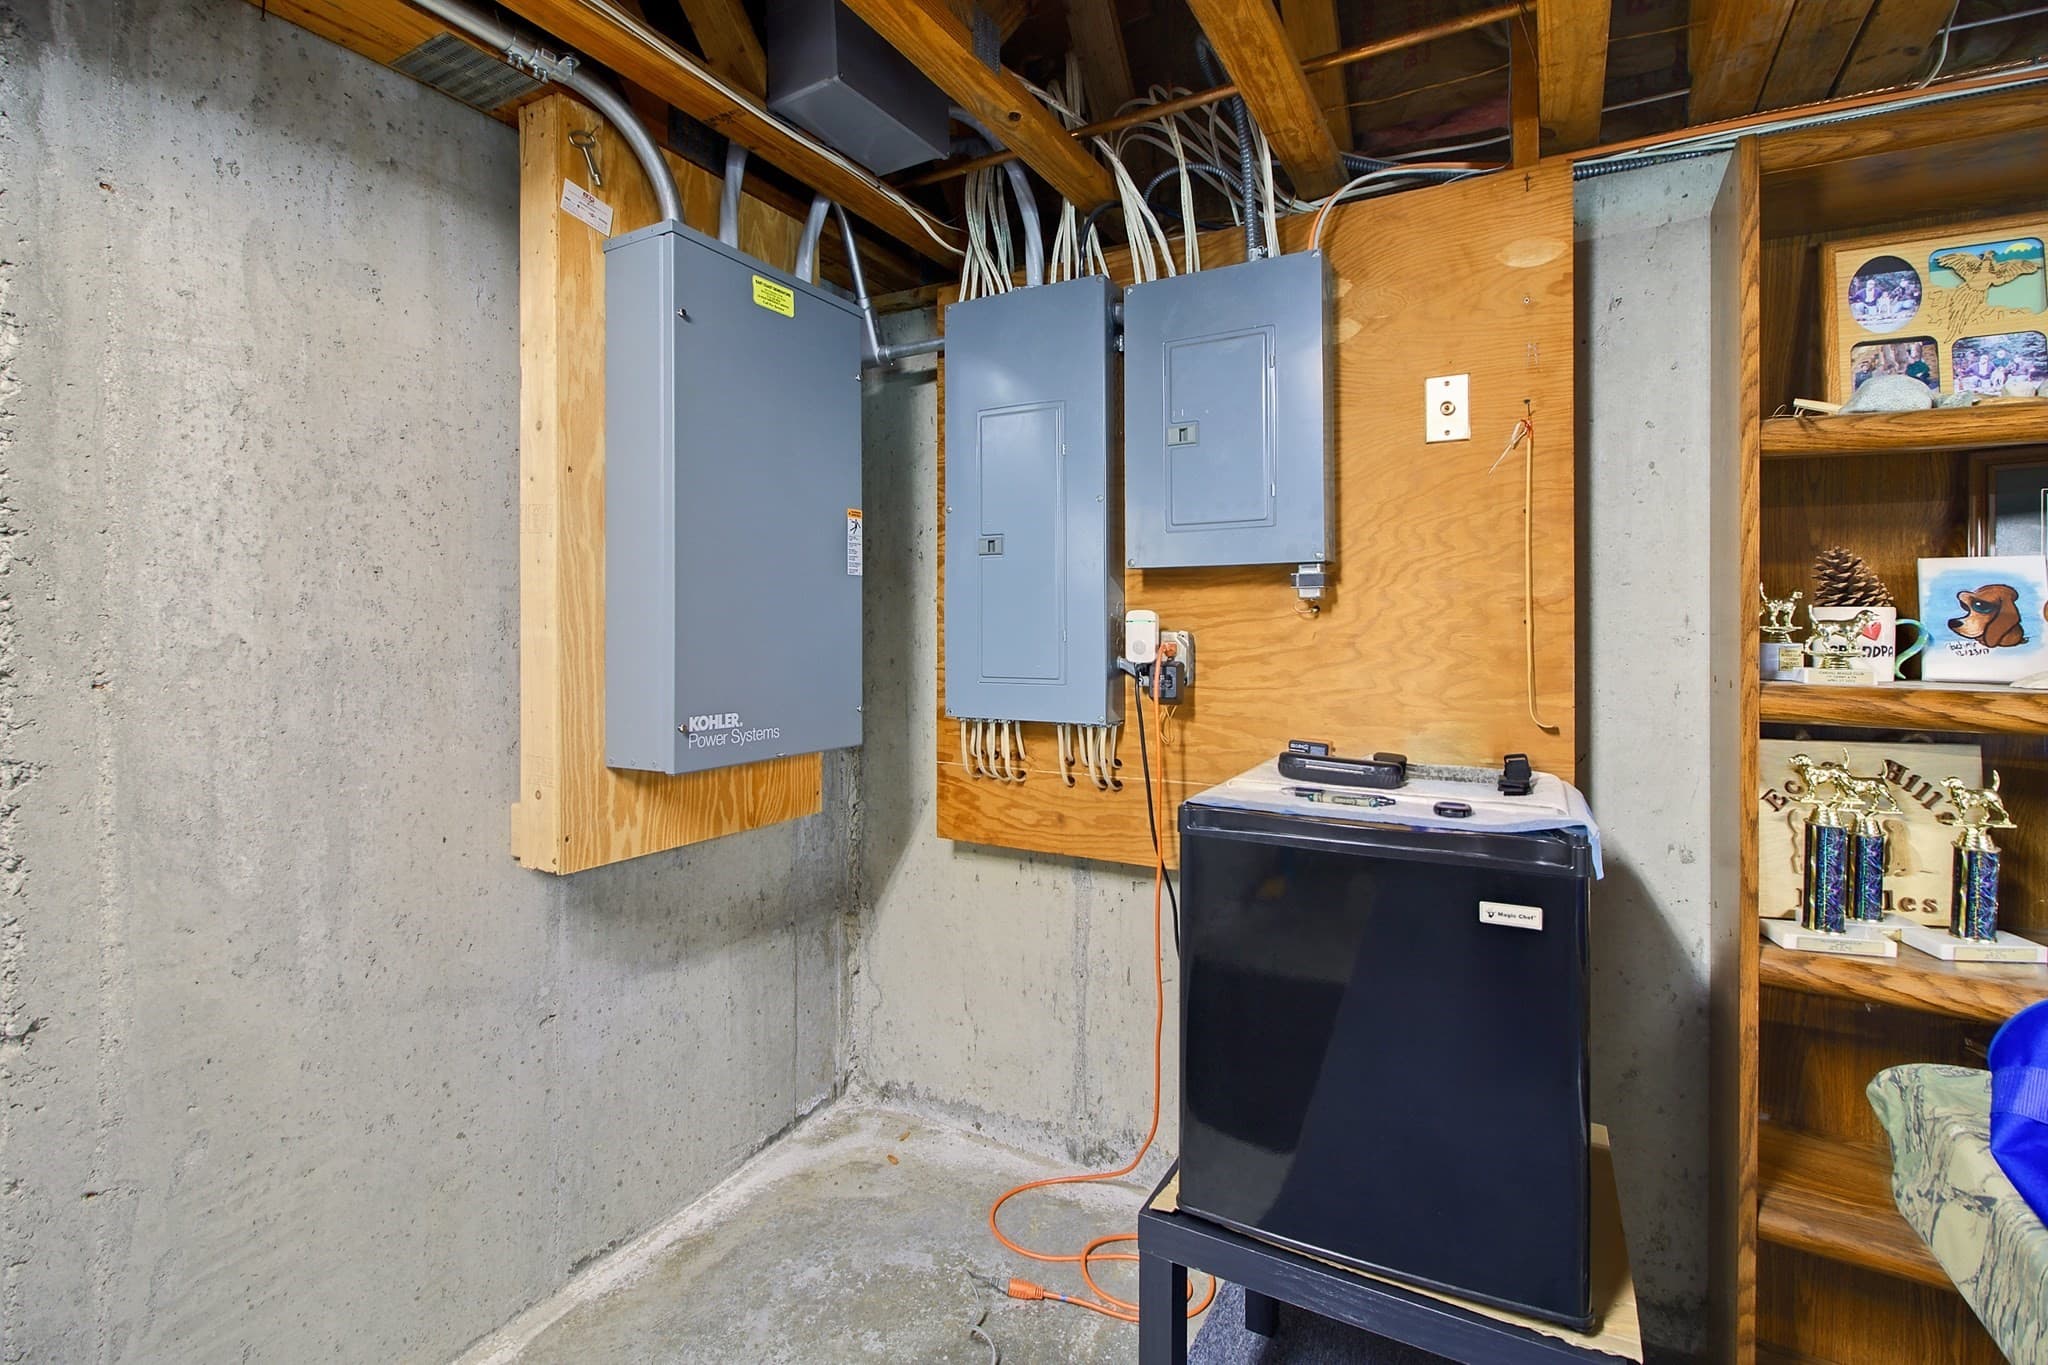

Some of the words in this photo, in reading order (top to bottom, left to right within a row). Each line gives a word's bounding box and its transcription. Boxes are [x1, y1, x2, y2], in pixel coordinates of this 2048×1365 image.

[688, 732, 728, 749] Power
[731, 727, 780, 746] Systems
[1497, 911, 1517, 919] Magic
[1518, 913, 1534, 921] Chef
